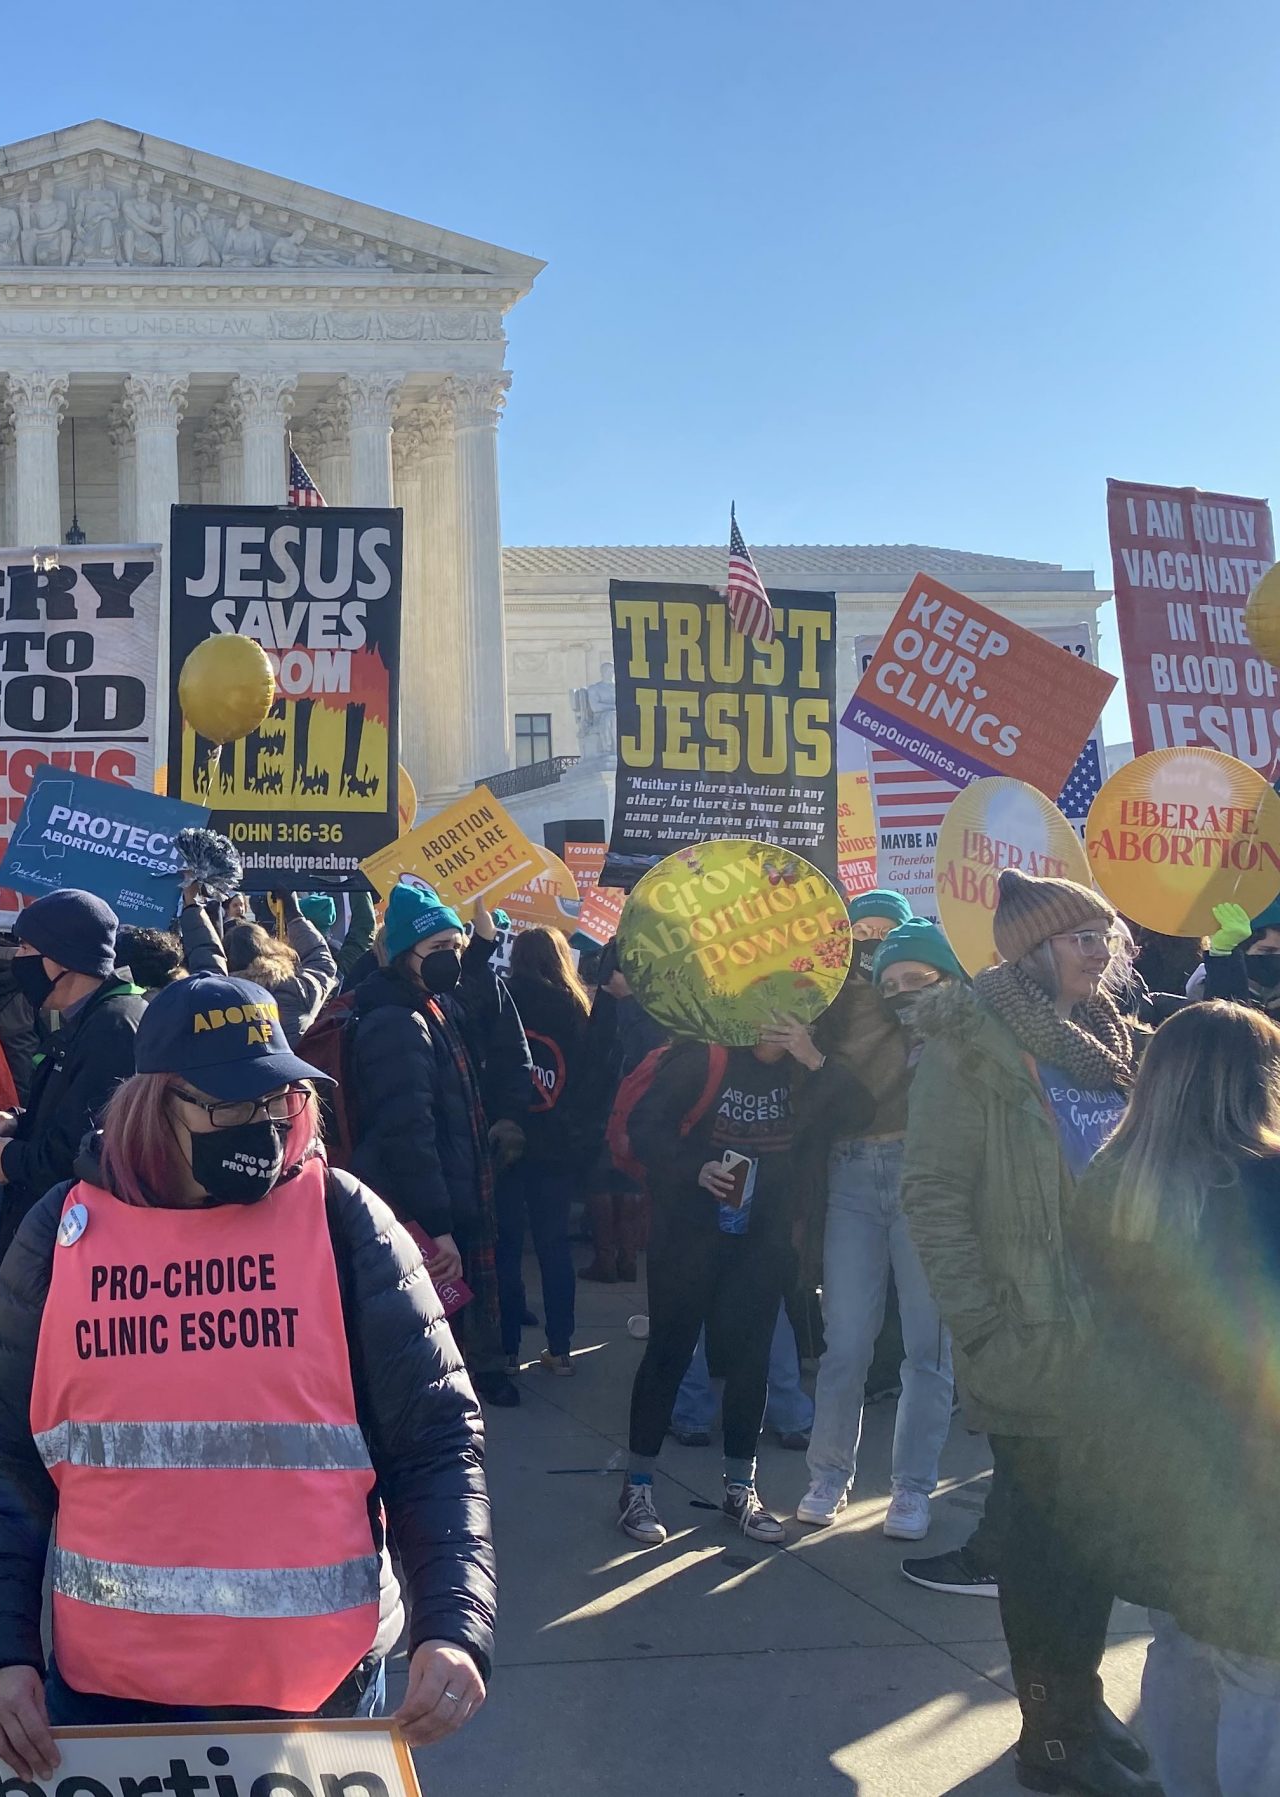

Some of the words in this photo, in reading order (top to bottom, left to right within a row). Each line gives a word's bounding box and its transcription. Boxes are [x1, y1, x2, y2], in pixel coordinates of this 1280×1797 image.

[24, 315, 114, 335] JUSTICE
[125, 315, 199, 335] UNDER
[207, 315, 253, 335] LAW
[1127, 497, 1138, 535] I
[1146, 500, 1185, 540] AM
[1190, 503, 1257, 548] FULLY
[185, 525, 391, 600] JESUS
[210, 599, 367, 650] SAVES
[615, 600, 831, 689] TRUST
[908, 591, 1009, 661] KEEP
[1167, 602, 1197, 642] IN
[1199, 605, 1250, 645] THE
[893, 628, 977, 694] OUR
[1150, 653, 1238, 696] BLOOD
[1245, 658, 1278, 698] OF
[875, 661, 1022, 757] CLINICS
[621, 688, 832, 778] JESUS
[626, 796, 668, 809] other;
[670, 796, 689, 808] for
[693, 797, 728, 810] there
[732, 800, 746, 810] is
[750, 803, 783, 813] none
[788, 803, 825, 815] other
[680, 782, 691, 792] is
[694, 782, 726, 793] there
[728, 783, 786, 797] salvation
[790, 786, 801, 798] in
[803, 788, 824, 802] any
[229, 823, 273, 842] JOHN
[277, 823, 343, 842] 3:16-36
[421, 806, 494, 861] ABORTION
[623, 828, 654, 840] men,
[657, 828, 707, 843] whereby
[625, 812, 659, 823] name
[662, 812, 696, 825] under
[699, 813, 742, 827] heaven
[745, 817, 779, 830] given
[783, 820, 825, 833] among
[1120, 799, 1260, 836] LIBERATE
[41, 828, 117, 859] ABORTION
[116, 849, 179, 875] ACCESS
[435, 844, 476, 878] BANS
[477, 824, 508, 853] ARE
[882, 833, 923, 849] MAYBE
[1089, 827, 1280, 873] ABORTION
[453, 844, 527, 896] RACIST.
[648, 851, 765, 918] Grow
[888, 870, 911, 881] God
[903, 886, 934, 896] nation
[116, 899, 140, 912] RIGHTS
[119, 894, 165, 913] REPRODUCTIVE
[120, 888, 145, 899] CENTER
[626, 874, 829, 967] Abortion
[684, 905, 837, 979] Power
[247, 1024, 273, 1045] AF
[222, 1160, 244, 1173] PRO
[235, 1152, 257, 1165] PRO
[90, 1253, 277, 1302] PRO-CHOICE
[75, 1314, 169, 1361] CLINIC
[180, 1307, 299, 1352] ESCORT
